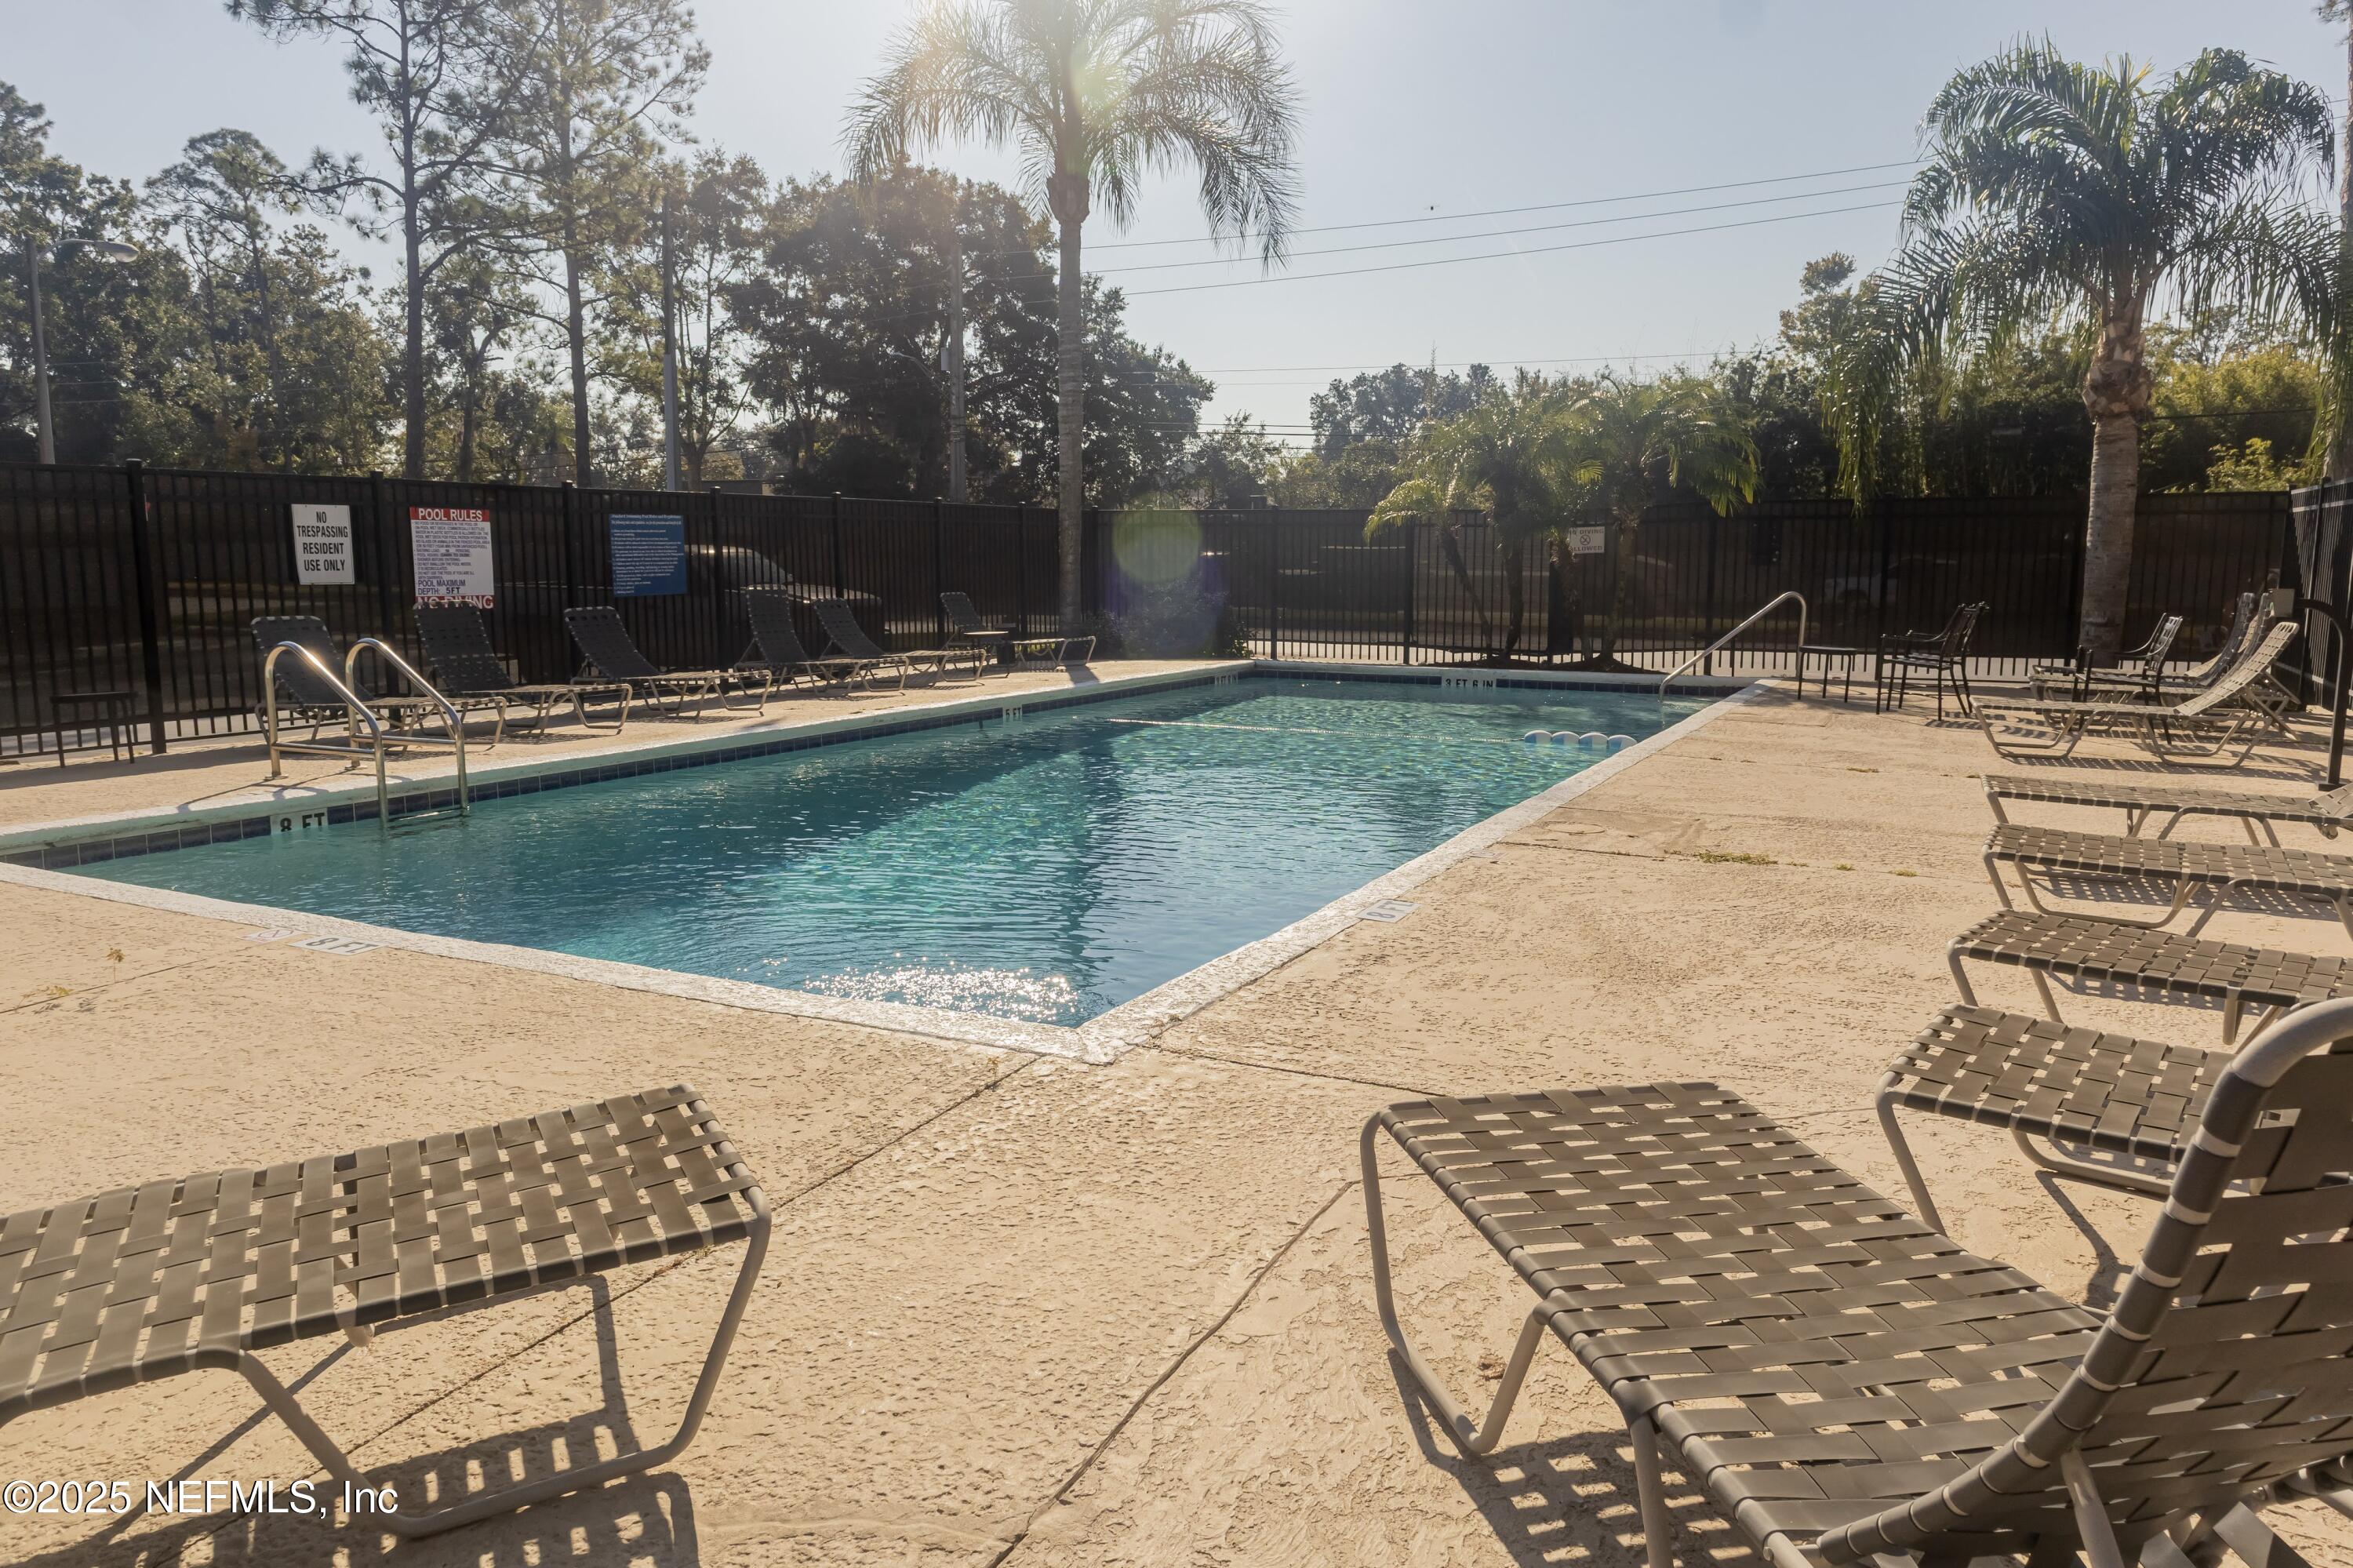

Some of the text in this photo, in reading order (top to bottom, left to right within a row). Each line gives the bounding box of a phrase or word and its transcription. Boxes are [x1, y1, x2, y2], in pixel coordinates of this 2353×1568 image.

[316, 511, 327, 523] NO
[418, 508, 482, 521] POOL RULES
[297, 526, 348, 537] TRESPASSING
[303, 543, 344, 554] RESIDENT
[304, 559, 345, 571] USE ONLY
[1456, 679, 1468, 687] FT
[1013, 707, 1021, 715] FT
[280, 813, 325, 832] 8 FT
[1377, 901, 1414, 912] FT
[305, 937, 379, 954] 8 FT
